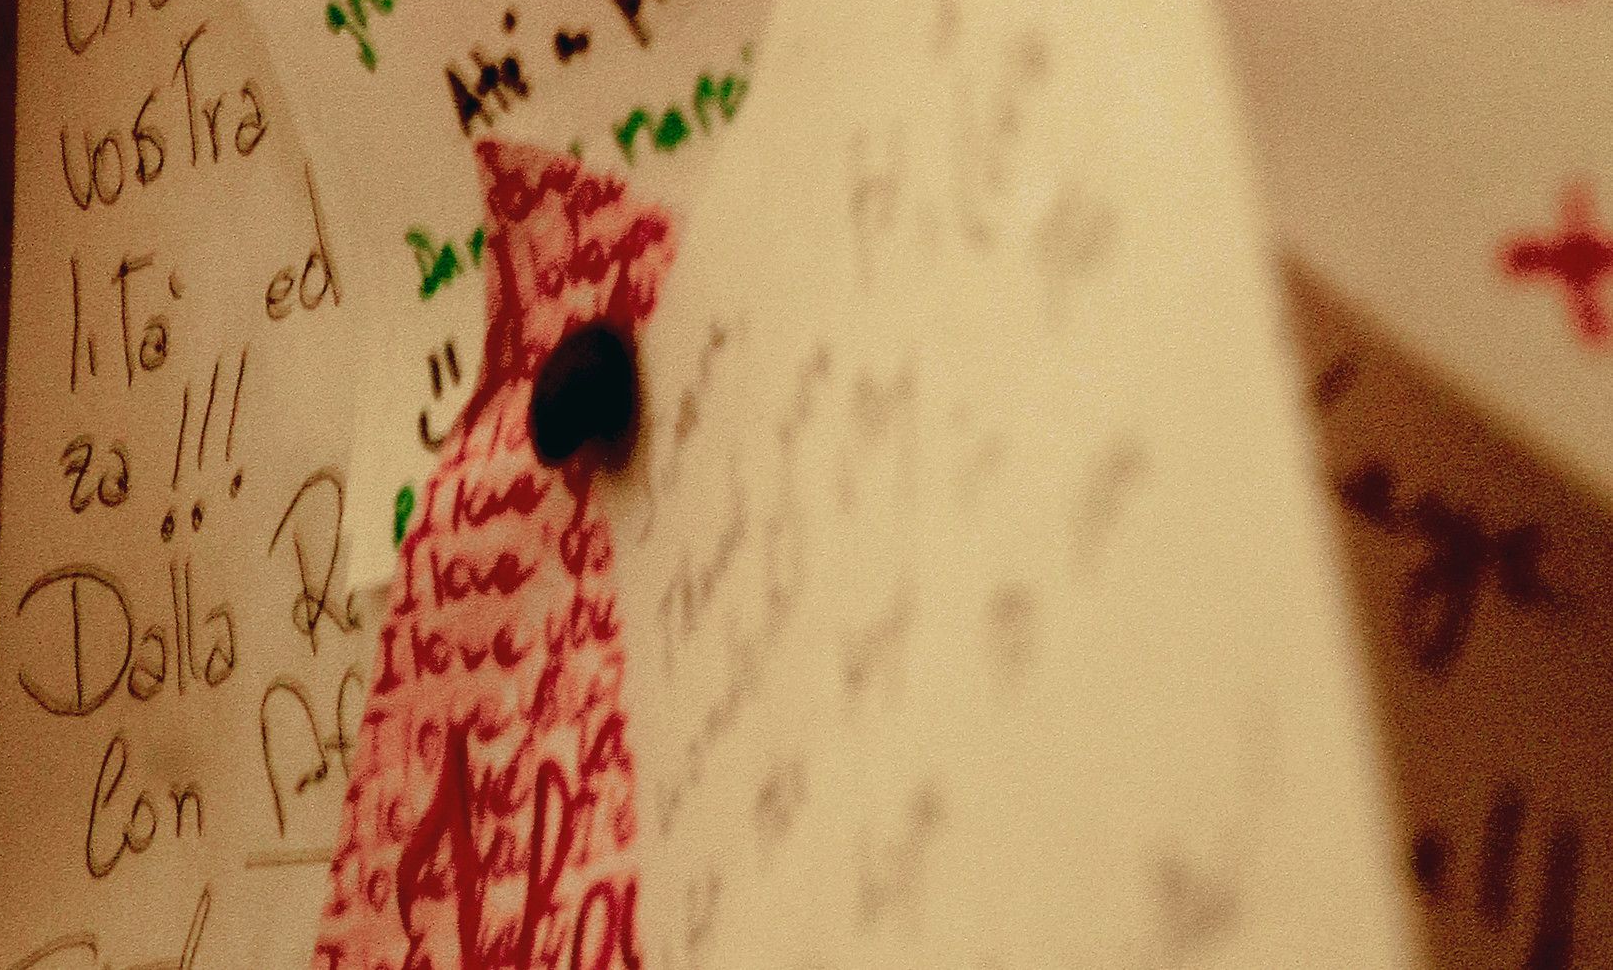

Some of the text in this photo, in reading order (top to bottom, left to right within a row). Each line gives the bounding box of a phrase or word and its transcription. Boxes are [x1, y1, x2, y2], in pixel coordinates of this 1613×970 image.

[265, 162, 343, 322] ed
[17, 560, 237, 720] Dalla
[86, 734, 207, 880] Con
